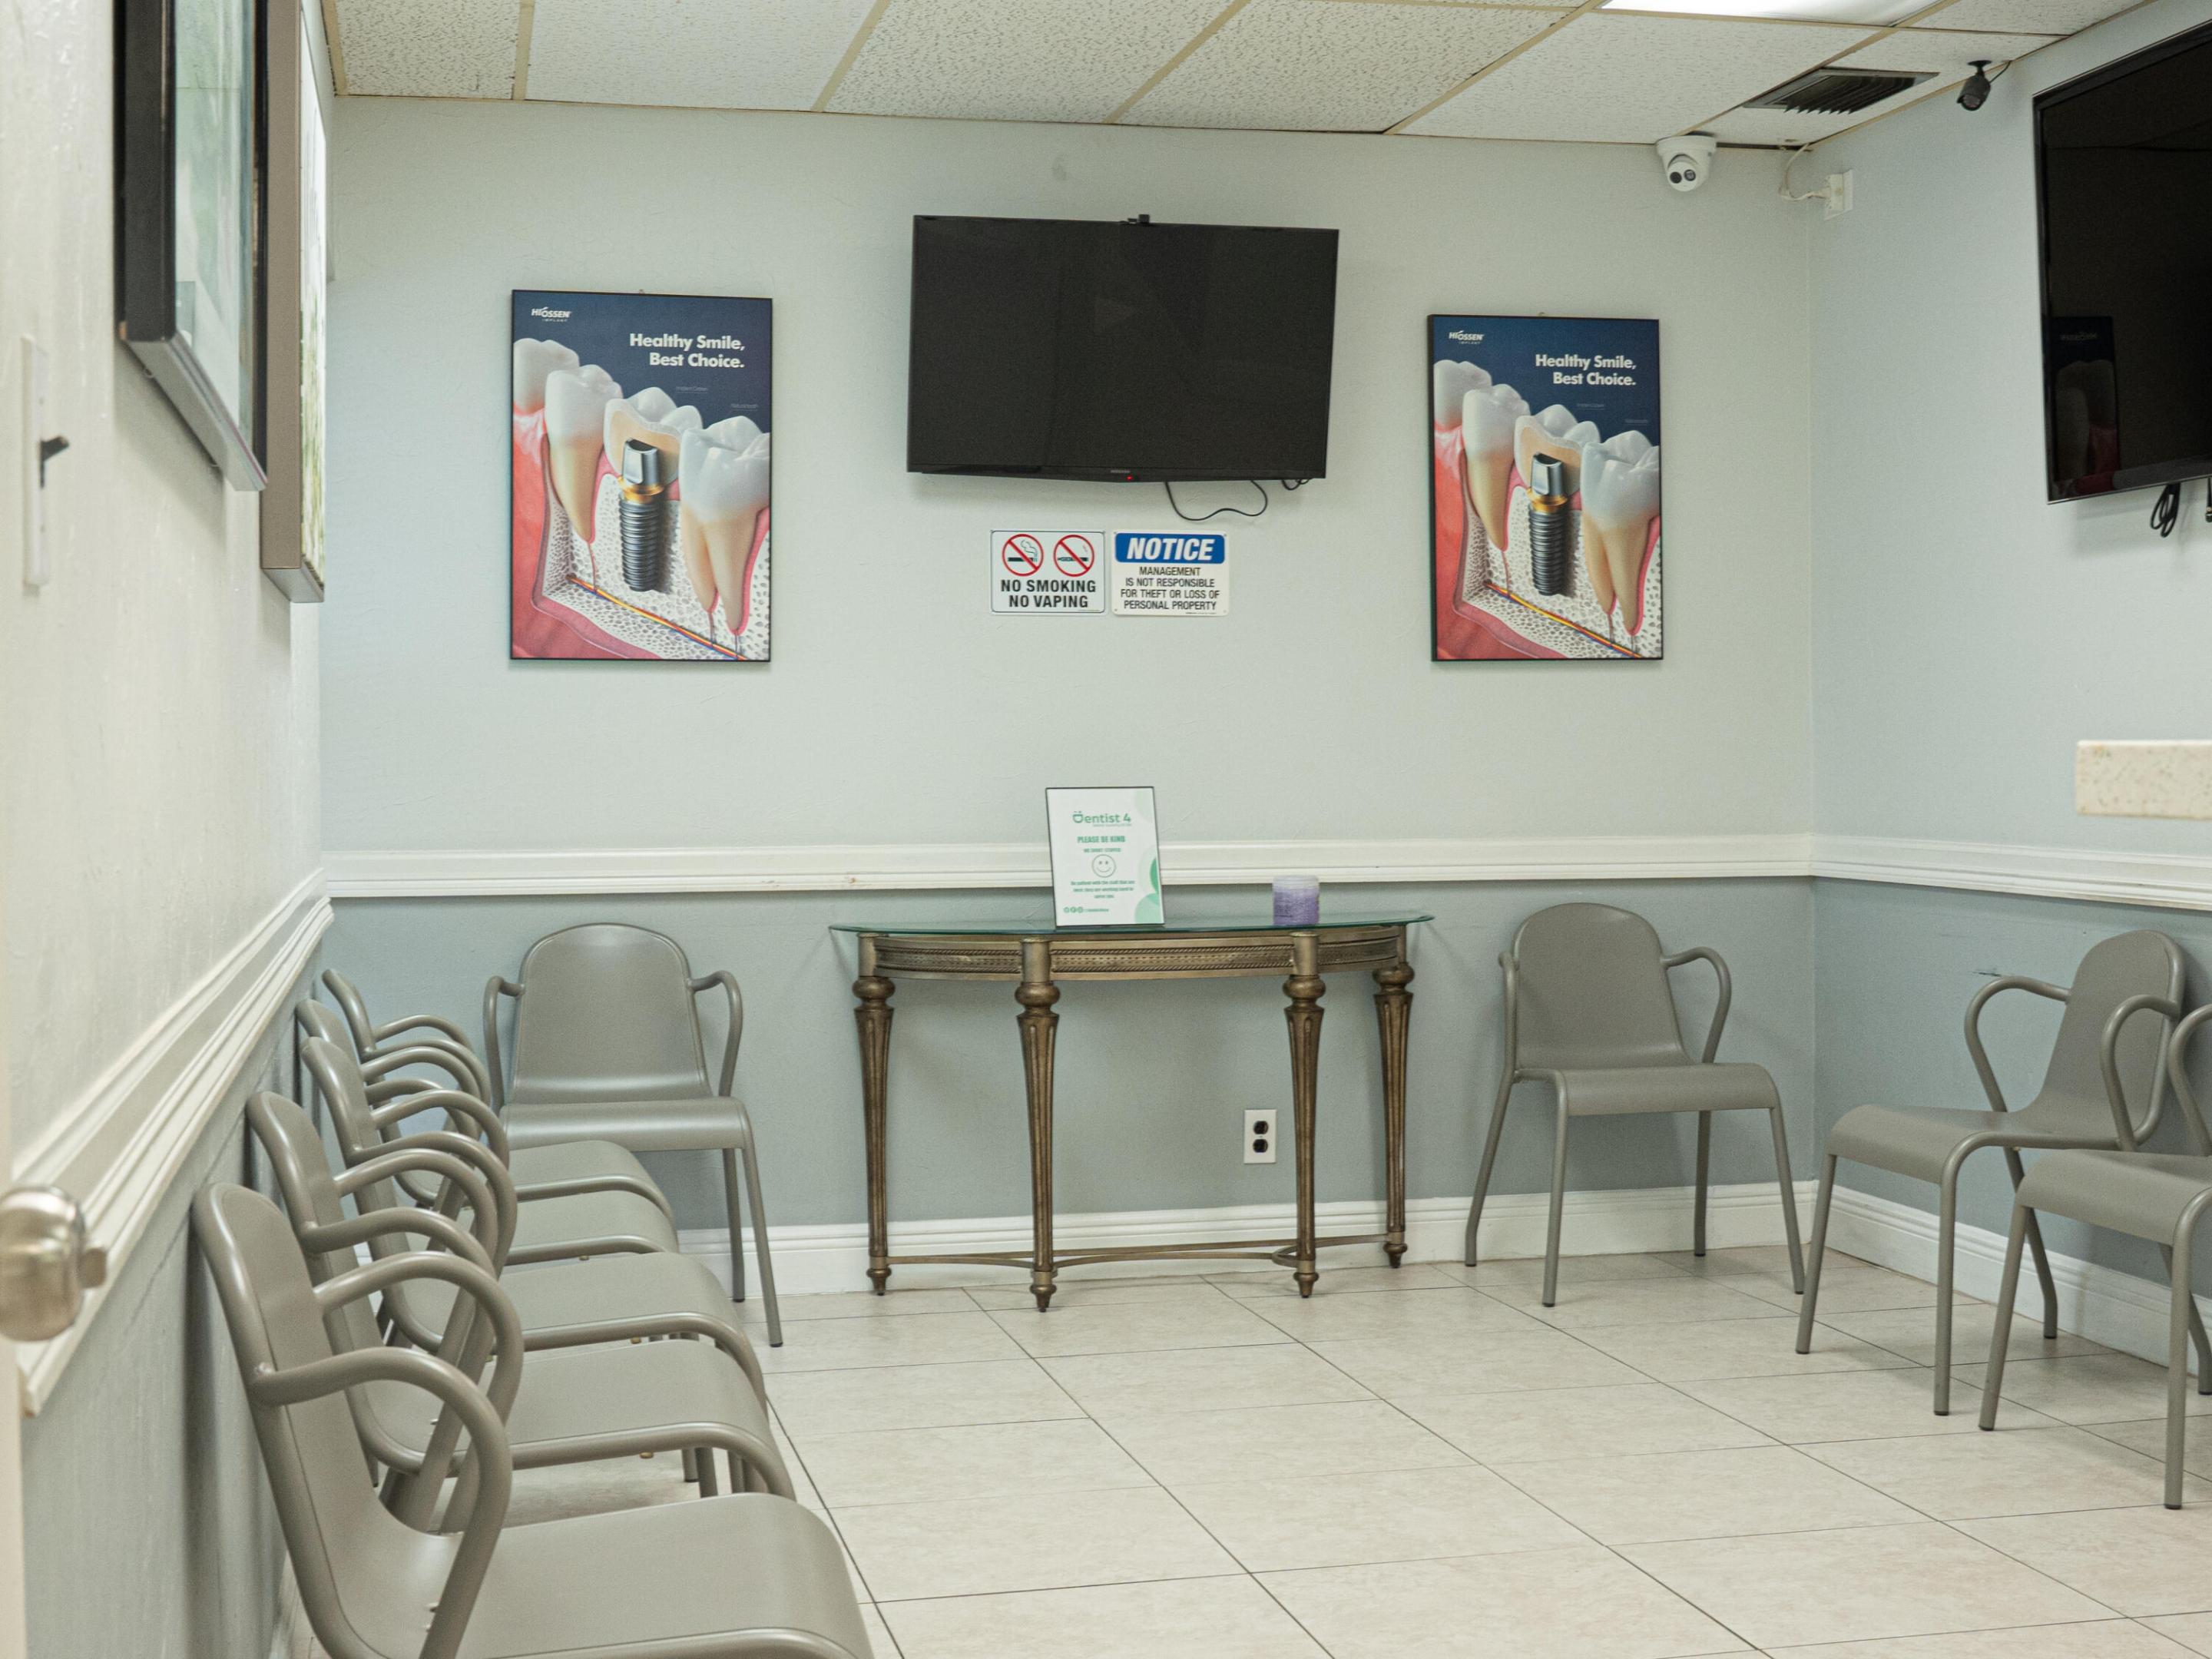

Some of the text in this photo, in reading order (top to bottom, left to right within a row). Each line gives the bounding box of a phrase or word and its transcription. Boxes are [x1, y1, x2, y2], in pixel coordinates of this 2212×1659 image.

[630, 333, 745, 351] Healthy Smile,
[650, 353, 745, 367] Best Choice.
[1535, 354, 1637, 370] Healthy Smile,
[1553, 372, 1637, 386] Best Choice.
[1127, 538, 1215, 561] NOTICE
[1140, 567, 1200, 576] MANAGEMENT
[1001, 579, 1096, 592] NO SMOKING
[1126, 578, 1214, 588] IS NOT RESPONSIBLE
[1121, 589, 1220, 599] FOR THEFT OR LOSS OF
[1008, 595, 1088, 608] NO VAPING
[1124, 601, 1217, 610] PERSONAL PROPERTY
[1123, 813, 1131, 822] 4
